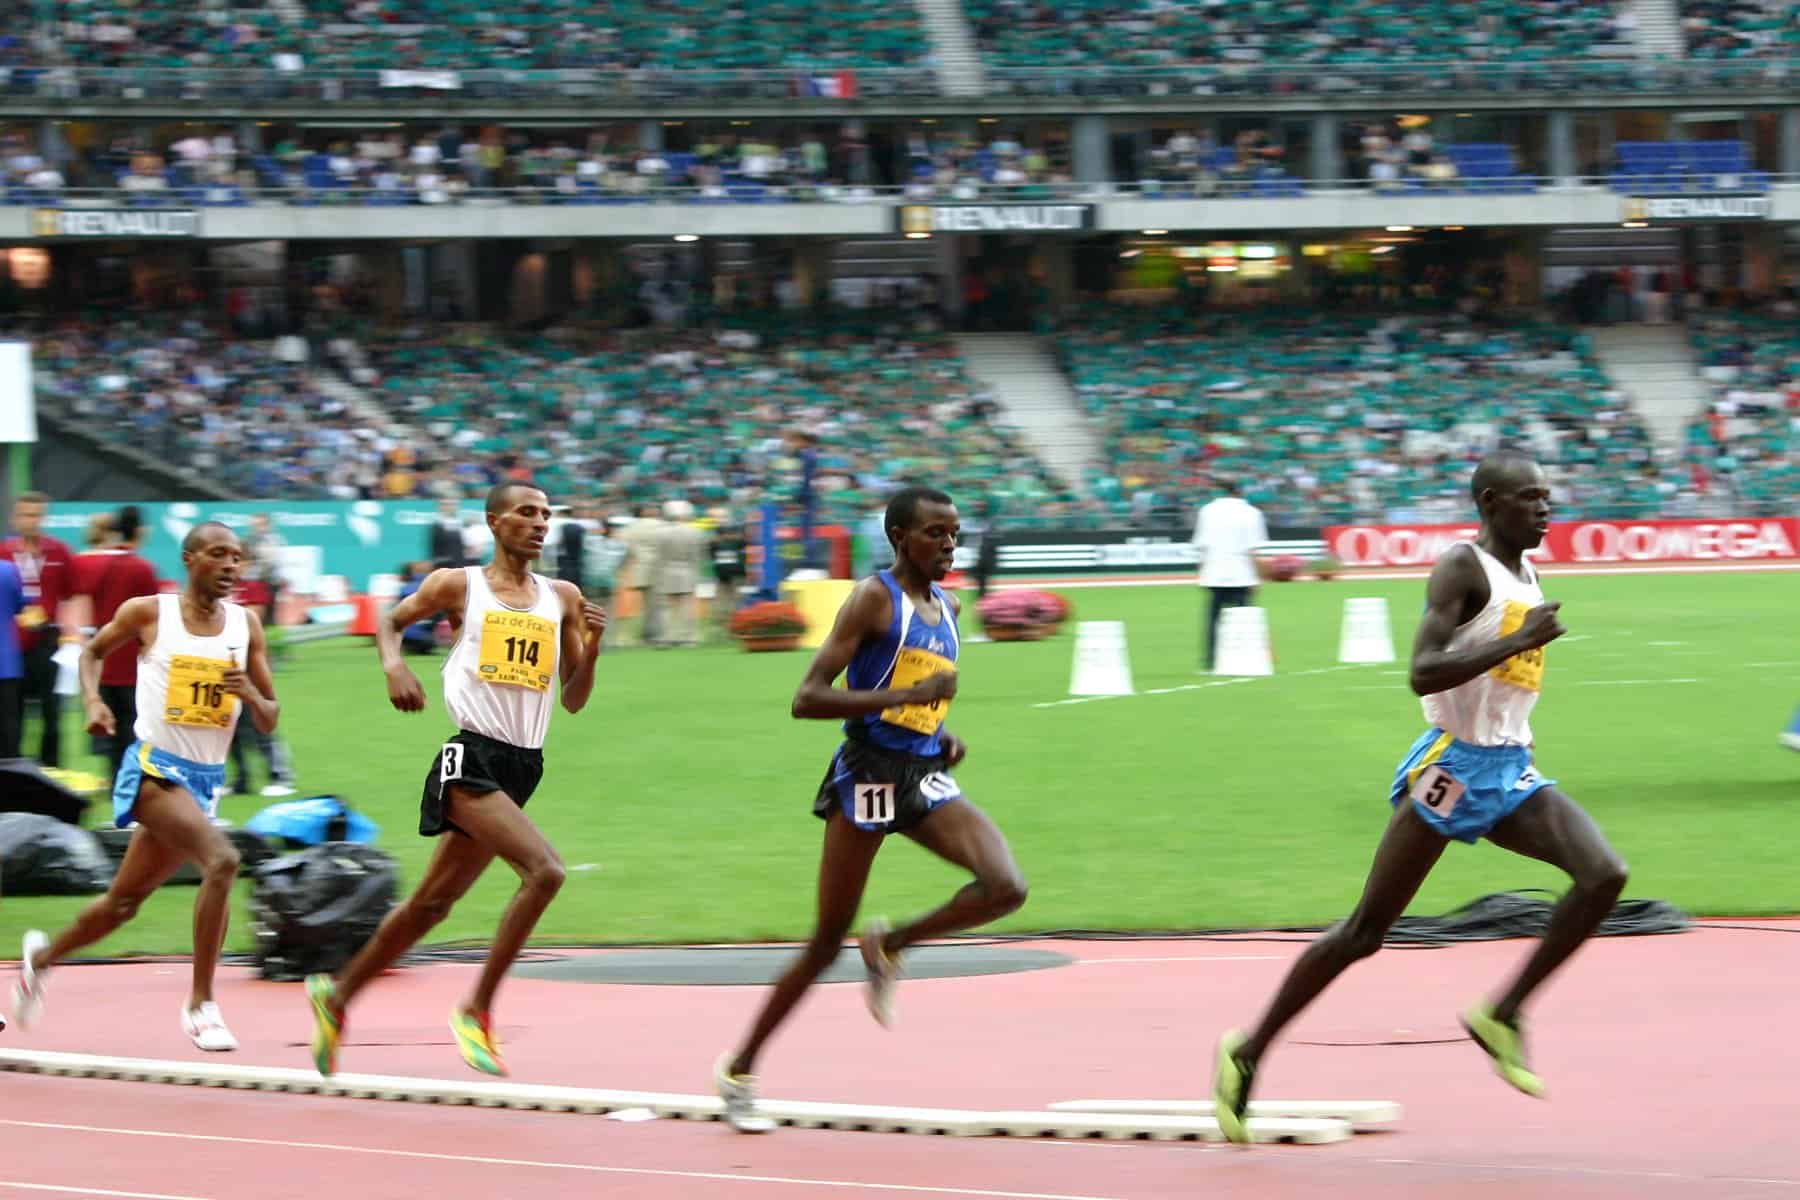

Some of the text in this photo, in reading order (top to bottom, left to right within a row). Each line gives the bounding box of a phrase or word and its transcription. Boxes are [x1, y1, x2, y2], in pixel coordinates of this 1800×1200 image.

[58, 211, 196, 236] RENAULT
[935, 205, 1085, 230] RENAULT
[1621, 523, 1796, 560] OMEGA
[504, 636, 540, 668] 114
[189, 681, 224, 709] 116
[444, 746, 458, 777] 3
[862, 787, 887, 820] 11
[1426, 774, 1453, 807] 5
